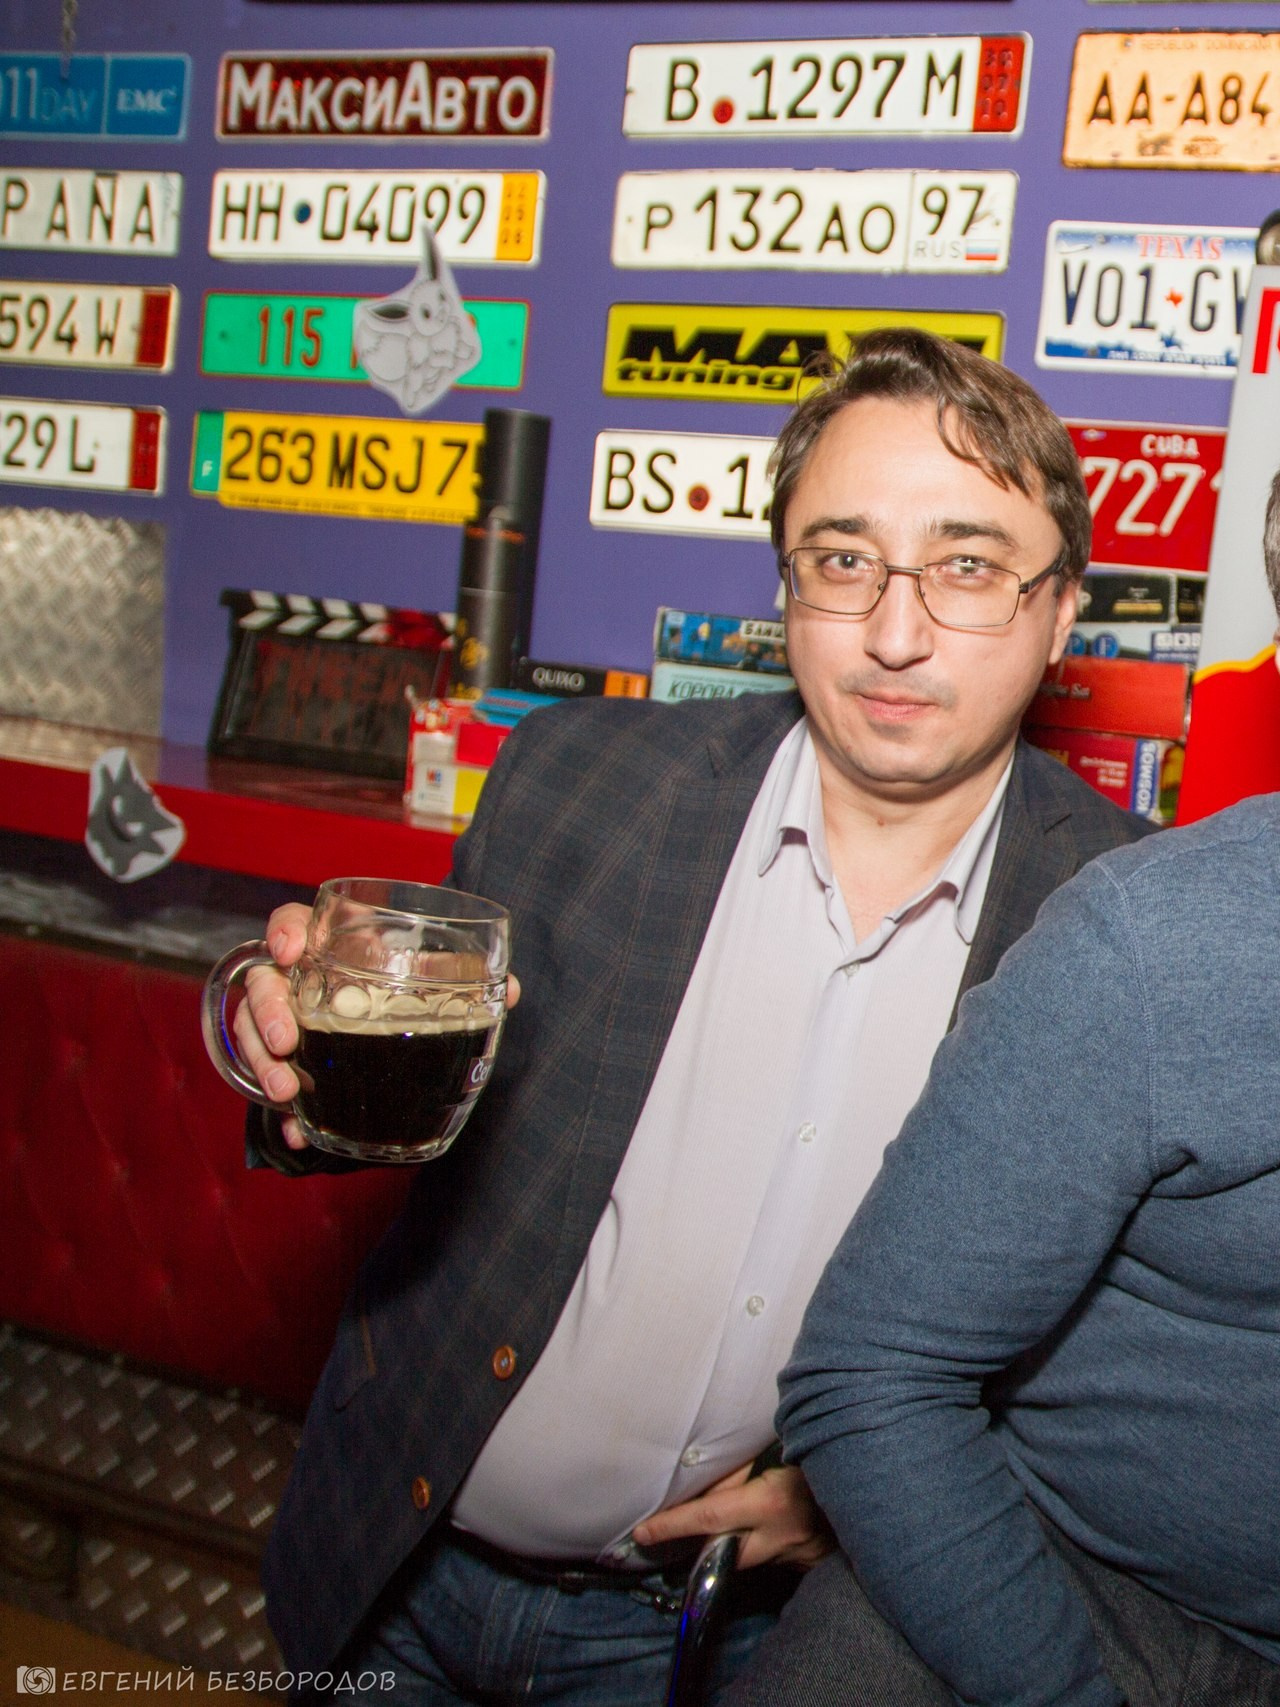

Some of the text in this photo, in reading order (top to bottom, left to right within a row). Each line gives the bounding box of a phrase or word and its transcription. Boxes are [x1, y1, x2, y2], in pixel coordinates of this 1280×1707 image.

[745, 51, 906, 122] 1297
[920, 184, 986, 237] 97
[911, 239, 963, 260] RUS
[1136, 233, 1226, 260] TEXAS
[258, 305, 326, 368] 115
[616, 358, 796, 391] tuning
[225, 425, 316, 486] 263
[327, 430, 425, 494] MSJ
[1140, 433, 1200, 459] CUBA
[1080, 456, 1224, 538] 727
[531, 666, 587, 694] QUIXO
[1134, 742, 1157, 815] KOSMOS
